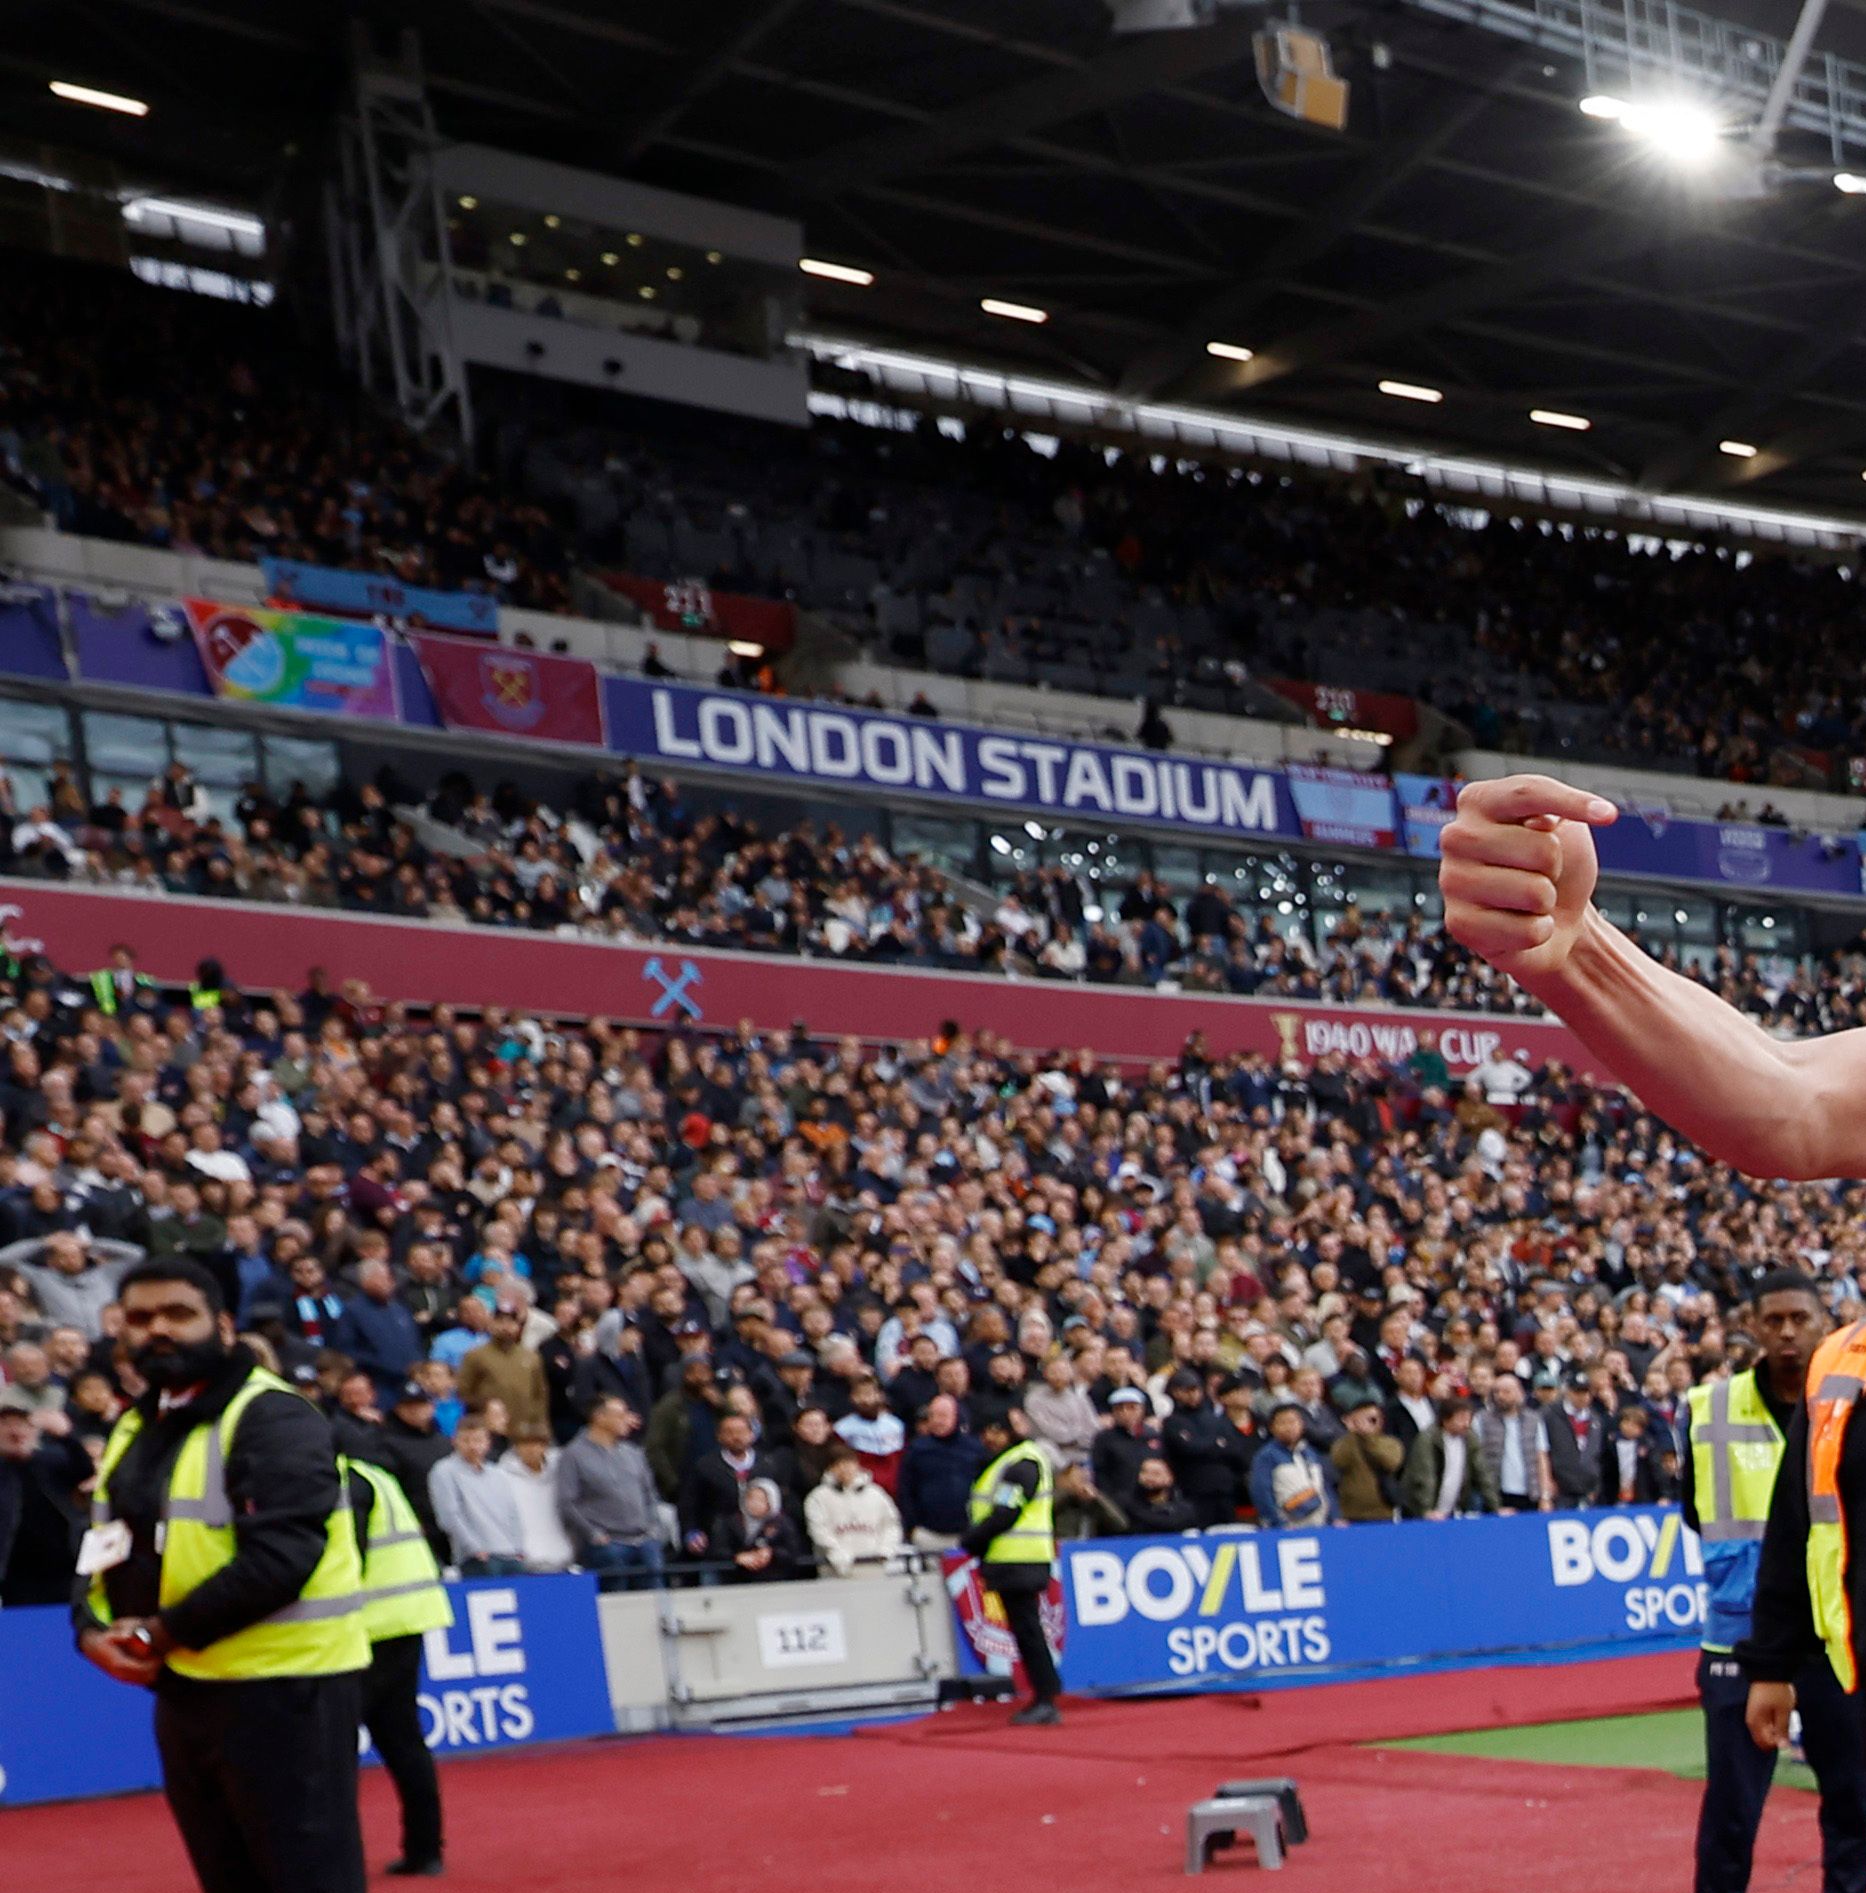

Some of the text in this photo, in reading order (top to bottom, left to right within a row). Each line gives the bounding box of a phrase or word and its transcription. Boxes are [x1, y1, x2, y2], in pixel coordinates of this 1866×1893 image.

[652, 691, 1279, 832] LONDON STADIUM
[1304, 1019, 1501, 1065] 1940 WA CUP
[1547, 1512, 1705, 1587] BOY
[1070, 1537, 1326, 1627] BOYLE
[1624, 1582, 1709, 1631] SPO
[778, 1623, 828, 1652] 112
[1167, 1615, 1331, 1675] SPORTS
[416, 1683, 534, 1749] ORTS
